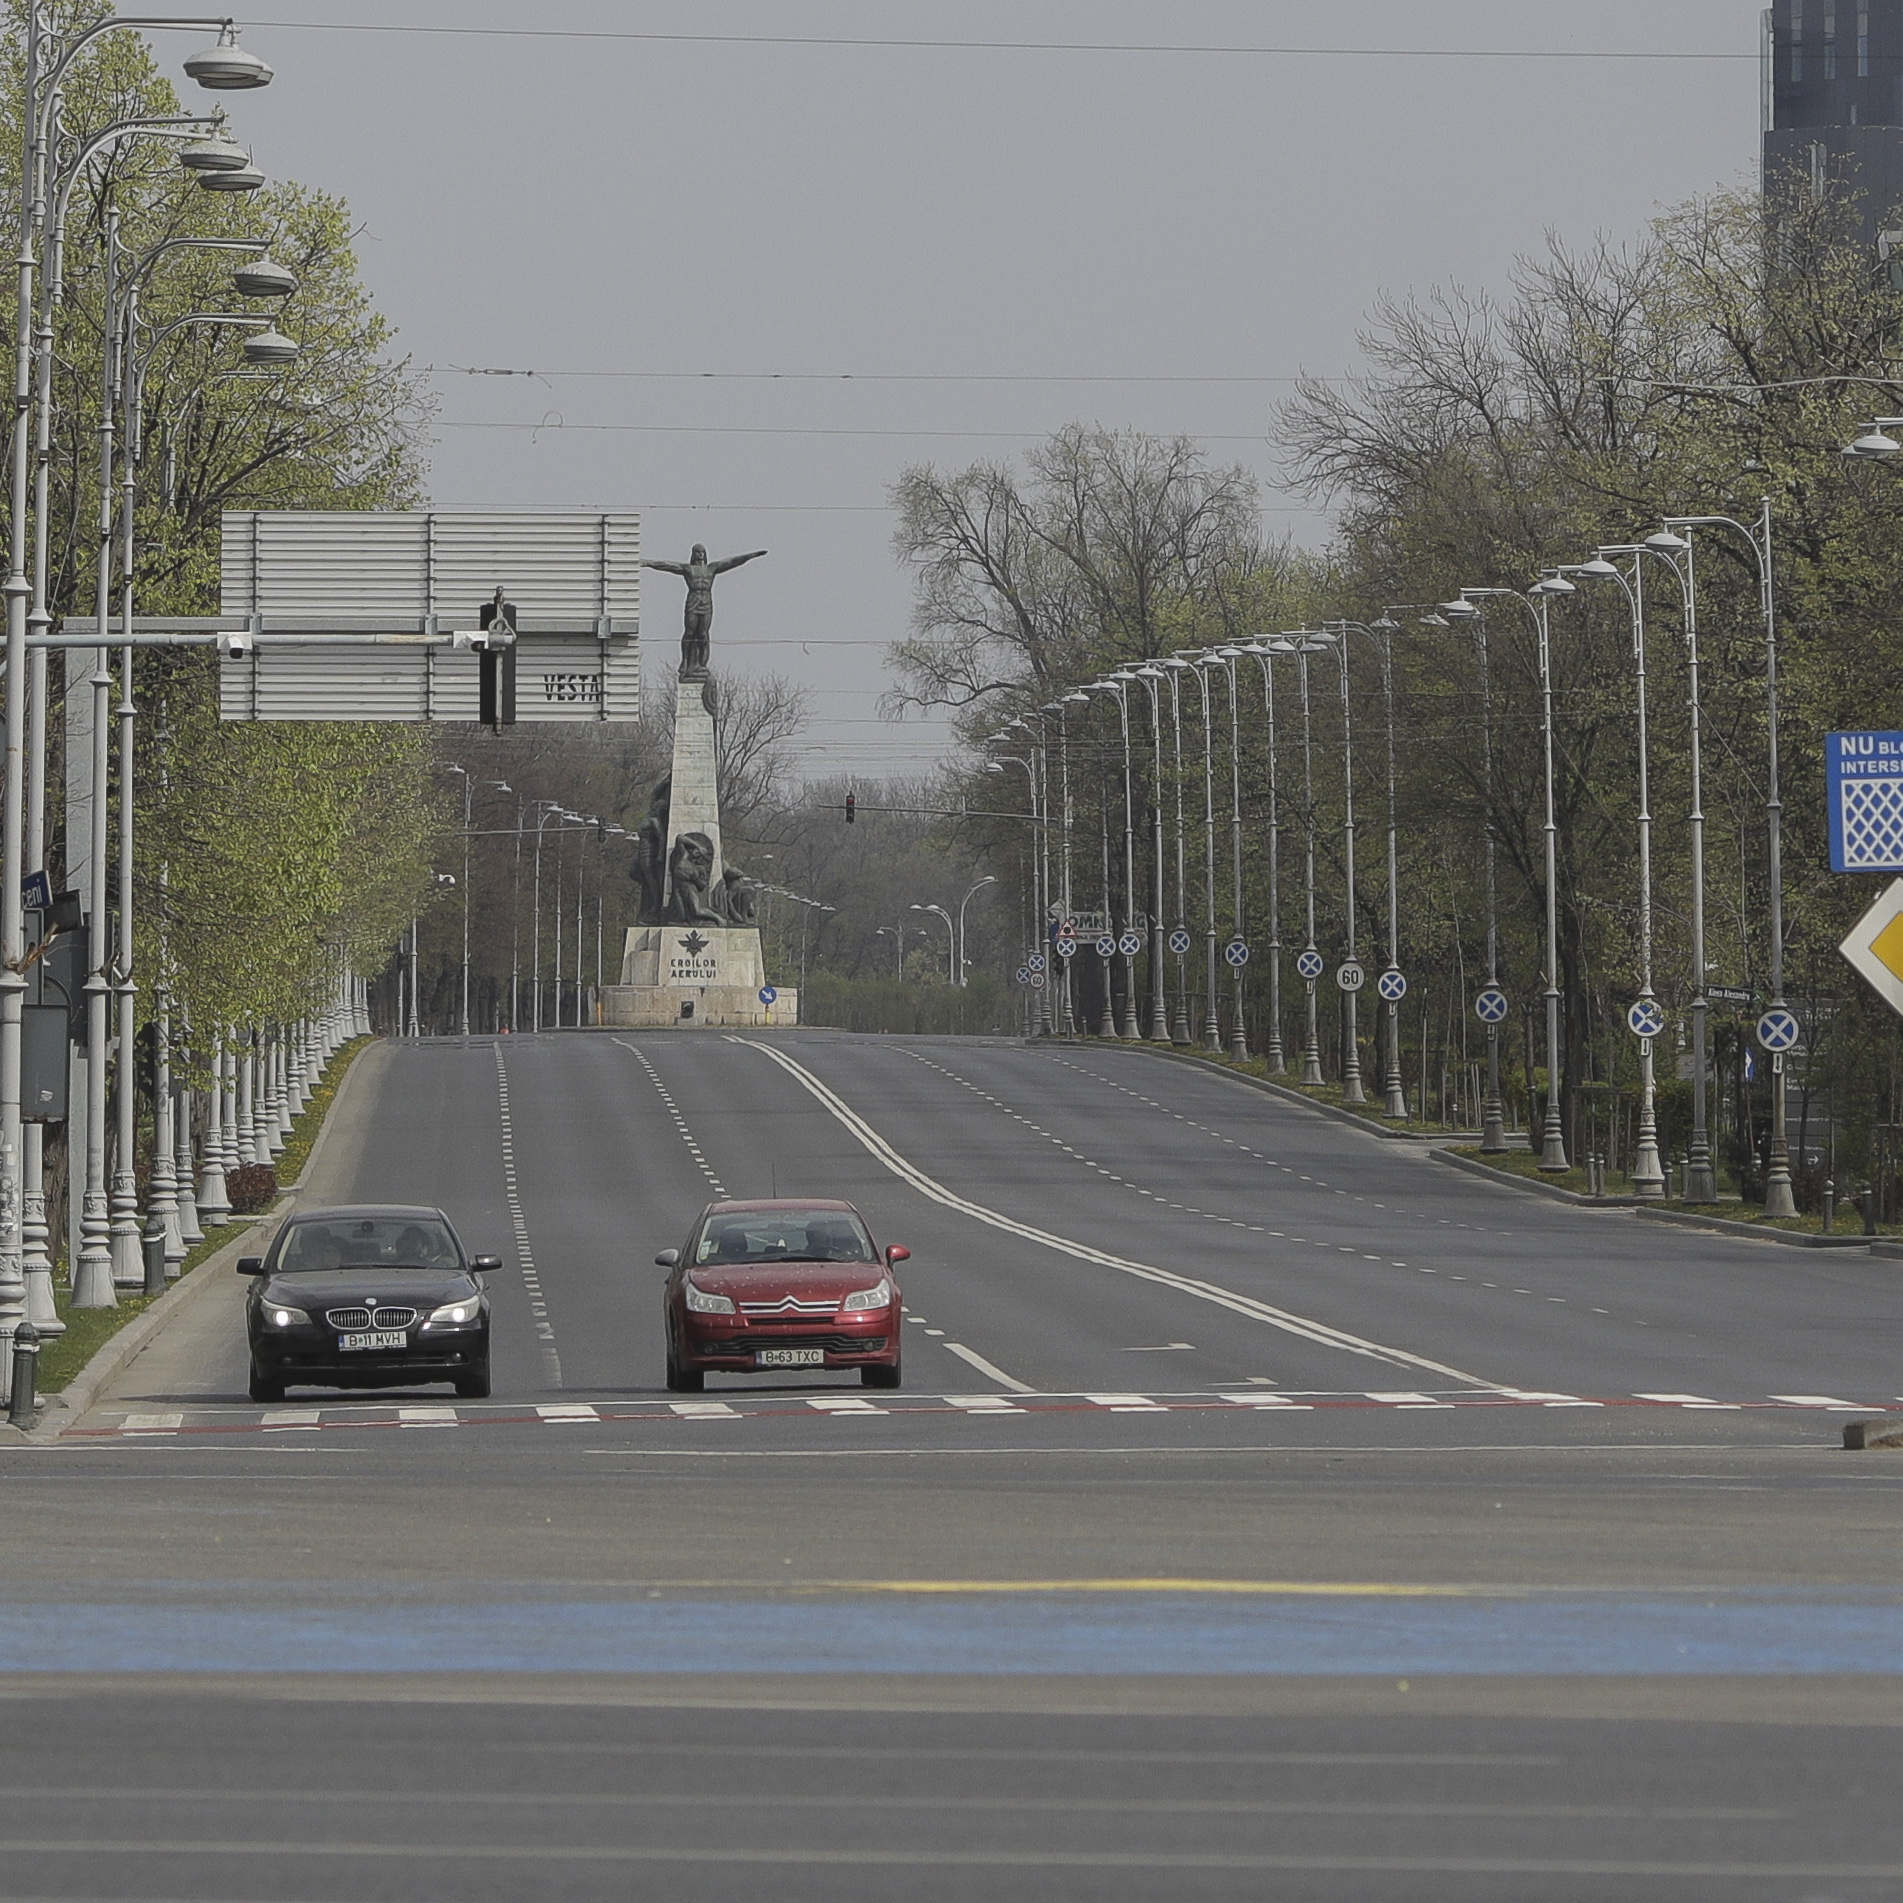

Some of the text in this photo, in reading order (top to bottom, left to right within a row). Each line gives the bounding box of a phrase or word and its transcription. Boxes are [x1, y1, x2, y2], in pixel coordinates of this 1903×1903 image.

[543, 674, 600, 701] VESTA
[1840, 736, 1874, 756] NU
[22, 884, 44, 908] ceni
[670, 958, 717, 968] EROILOR
[670, 969, 717, 979] AERULUI
[1342, 969, 1359, 985] 60
[349, 1332, 401, 1346] B 11 MVH
[765, 1350, 820, 1363] B 63 TXC
